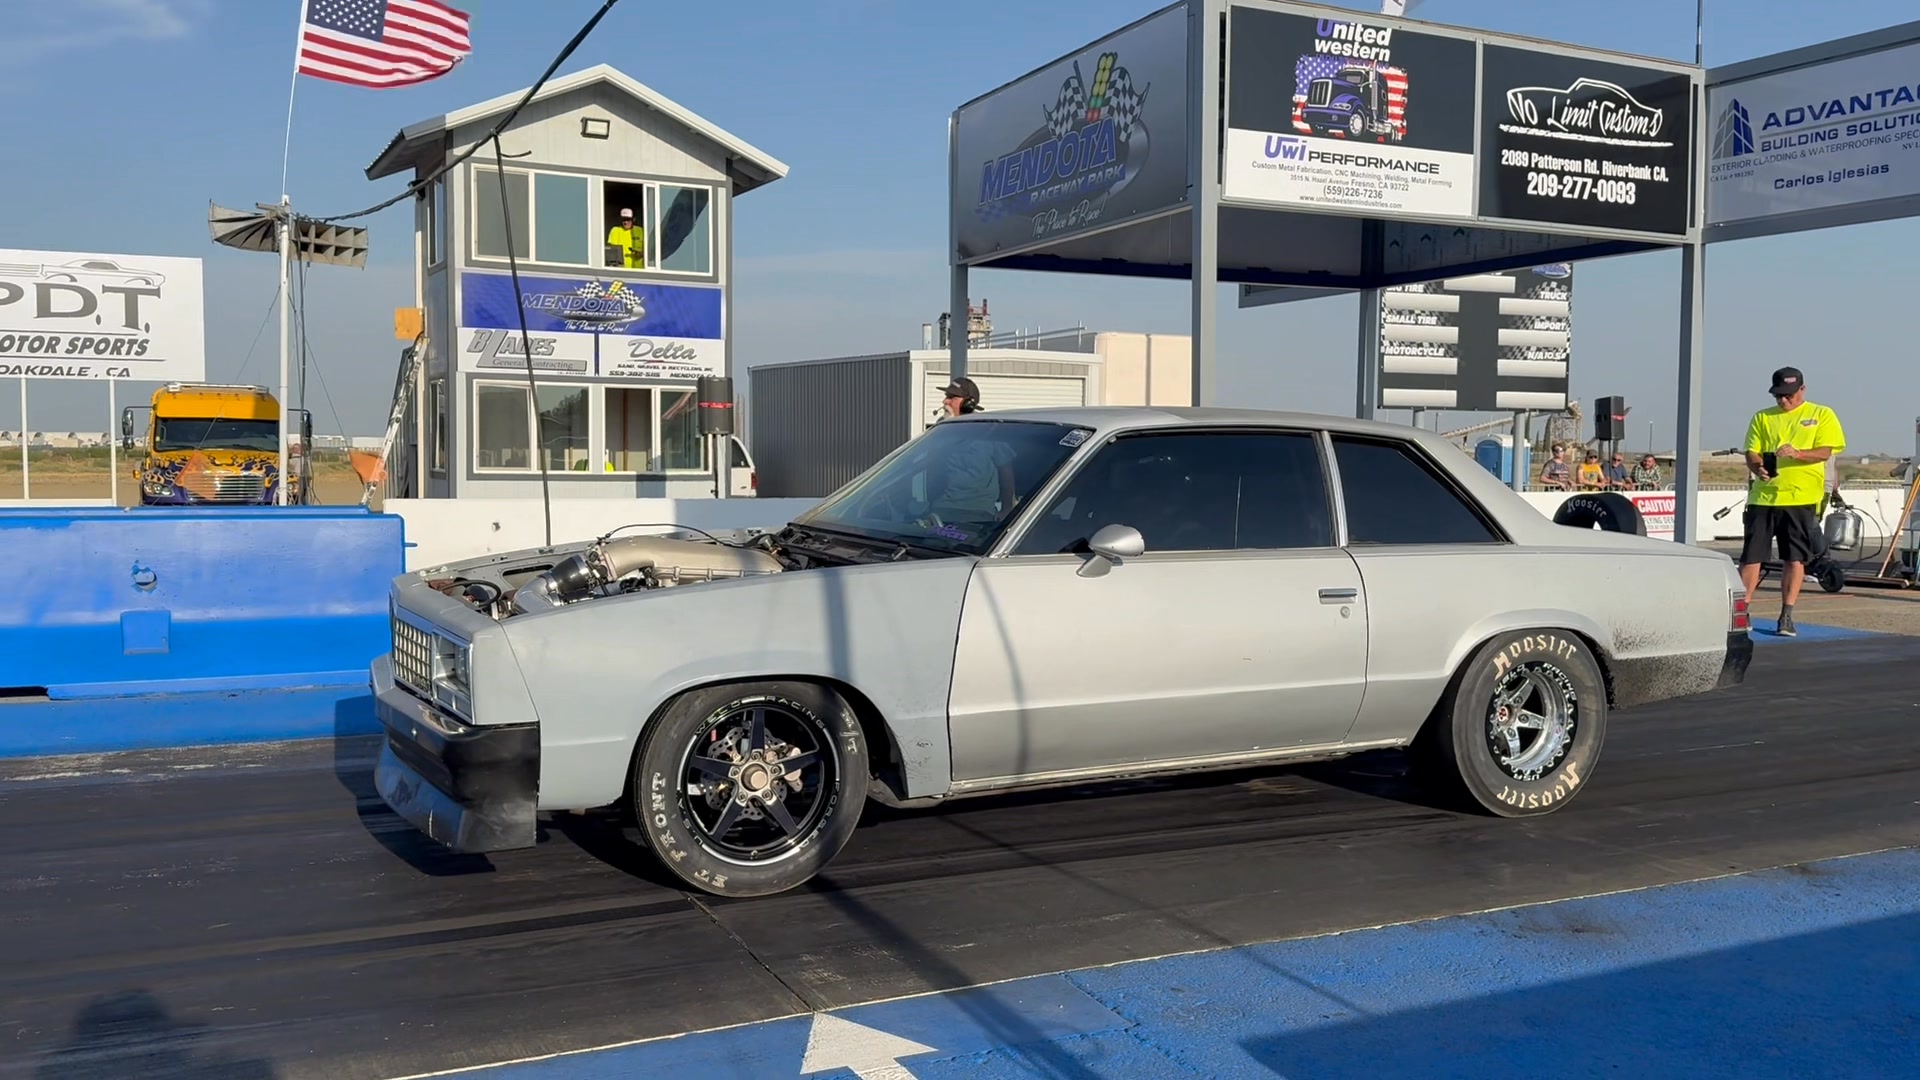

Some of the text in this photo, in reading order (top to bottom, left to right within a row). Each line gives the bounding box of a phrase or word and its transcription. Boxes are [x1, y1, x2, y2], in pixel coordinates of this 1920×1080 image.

[1316, 18, 1392, 46] United
[1314, 39, 1391, 62] western
[1547, 95, 1598, 131] Limit
[1600, 100, 1662, 137] Customs
[1762, 84, 1920, 131] ADVANTA
[1761, 128, 1839, 152] BUILDING
[979, 116, 1117, 206] MENDOTA
[1308, 151, 1440, 175] PERFORMANCE
[1501, 149, 1669, 182] 2089 Patterson Rd. Riverbank CA.
[1711, 159, 1751, 174] EXTERIOR
[1753, 151, 1798, 166] CLADDING
[1799, 149, 1807, 159] &
[1808, 134, 1892, 156] WATERPROOFING
[1030, 164, 1124, 203] RACEWAY PARK
[1251, 161, 1453, 188] Custom Metal Fabrication, CNC Machining, Welding, Metal Forming
[1328, 178, 1349, 186] Avenue
[1351, 178, 1377, 188] Fresno,
[1378, 181, 1389, 189] CA
[1390, 182, 1409, 191] 93722
[1774, 163, 1890, 190] Carlos Iglesias
[1323, 184, 1383, 199] (559)226-7236
[1527, 171, 1636, 205] 209-277-0093
[1044, 208, 1066, 231] Place
[1404, 284, 1424, 293] TIRE
[1539, 291, 1567, 300] TRUCK
[520, 293, 626, 313] MENDOTA
[565, 319, 577, 330] The
[577, 320, 597, 331] Place
[1385, 315, 1438, 325] SMALL TIRE
[1534, 321, 1567, 330] IMPORT
[64, 337, 150, 357] SPORTS
[627, 338, 697, 361] Delta
[1385, 346, 1445, 356] MOTORCYCLE
[106, 366, 131, 378] CA
[492, 358, 573, 370] General ontracting
[1638, 498, 1676, 513] CAUTIO
[1542, 661, 1578, 702] RACING
[766, 694, 827, 730] RACING
[800, 780, 841, 849] FORGED
[651, 771, 728, 889] ET FRONT
